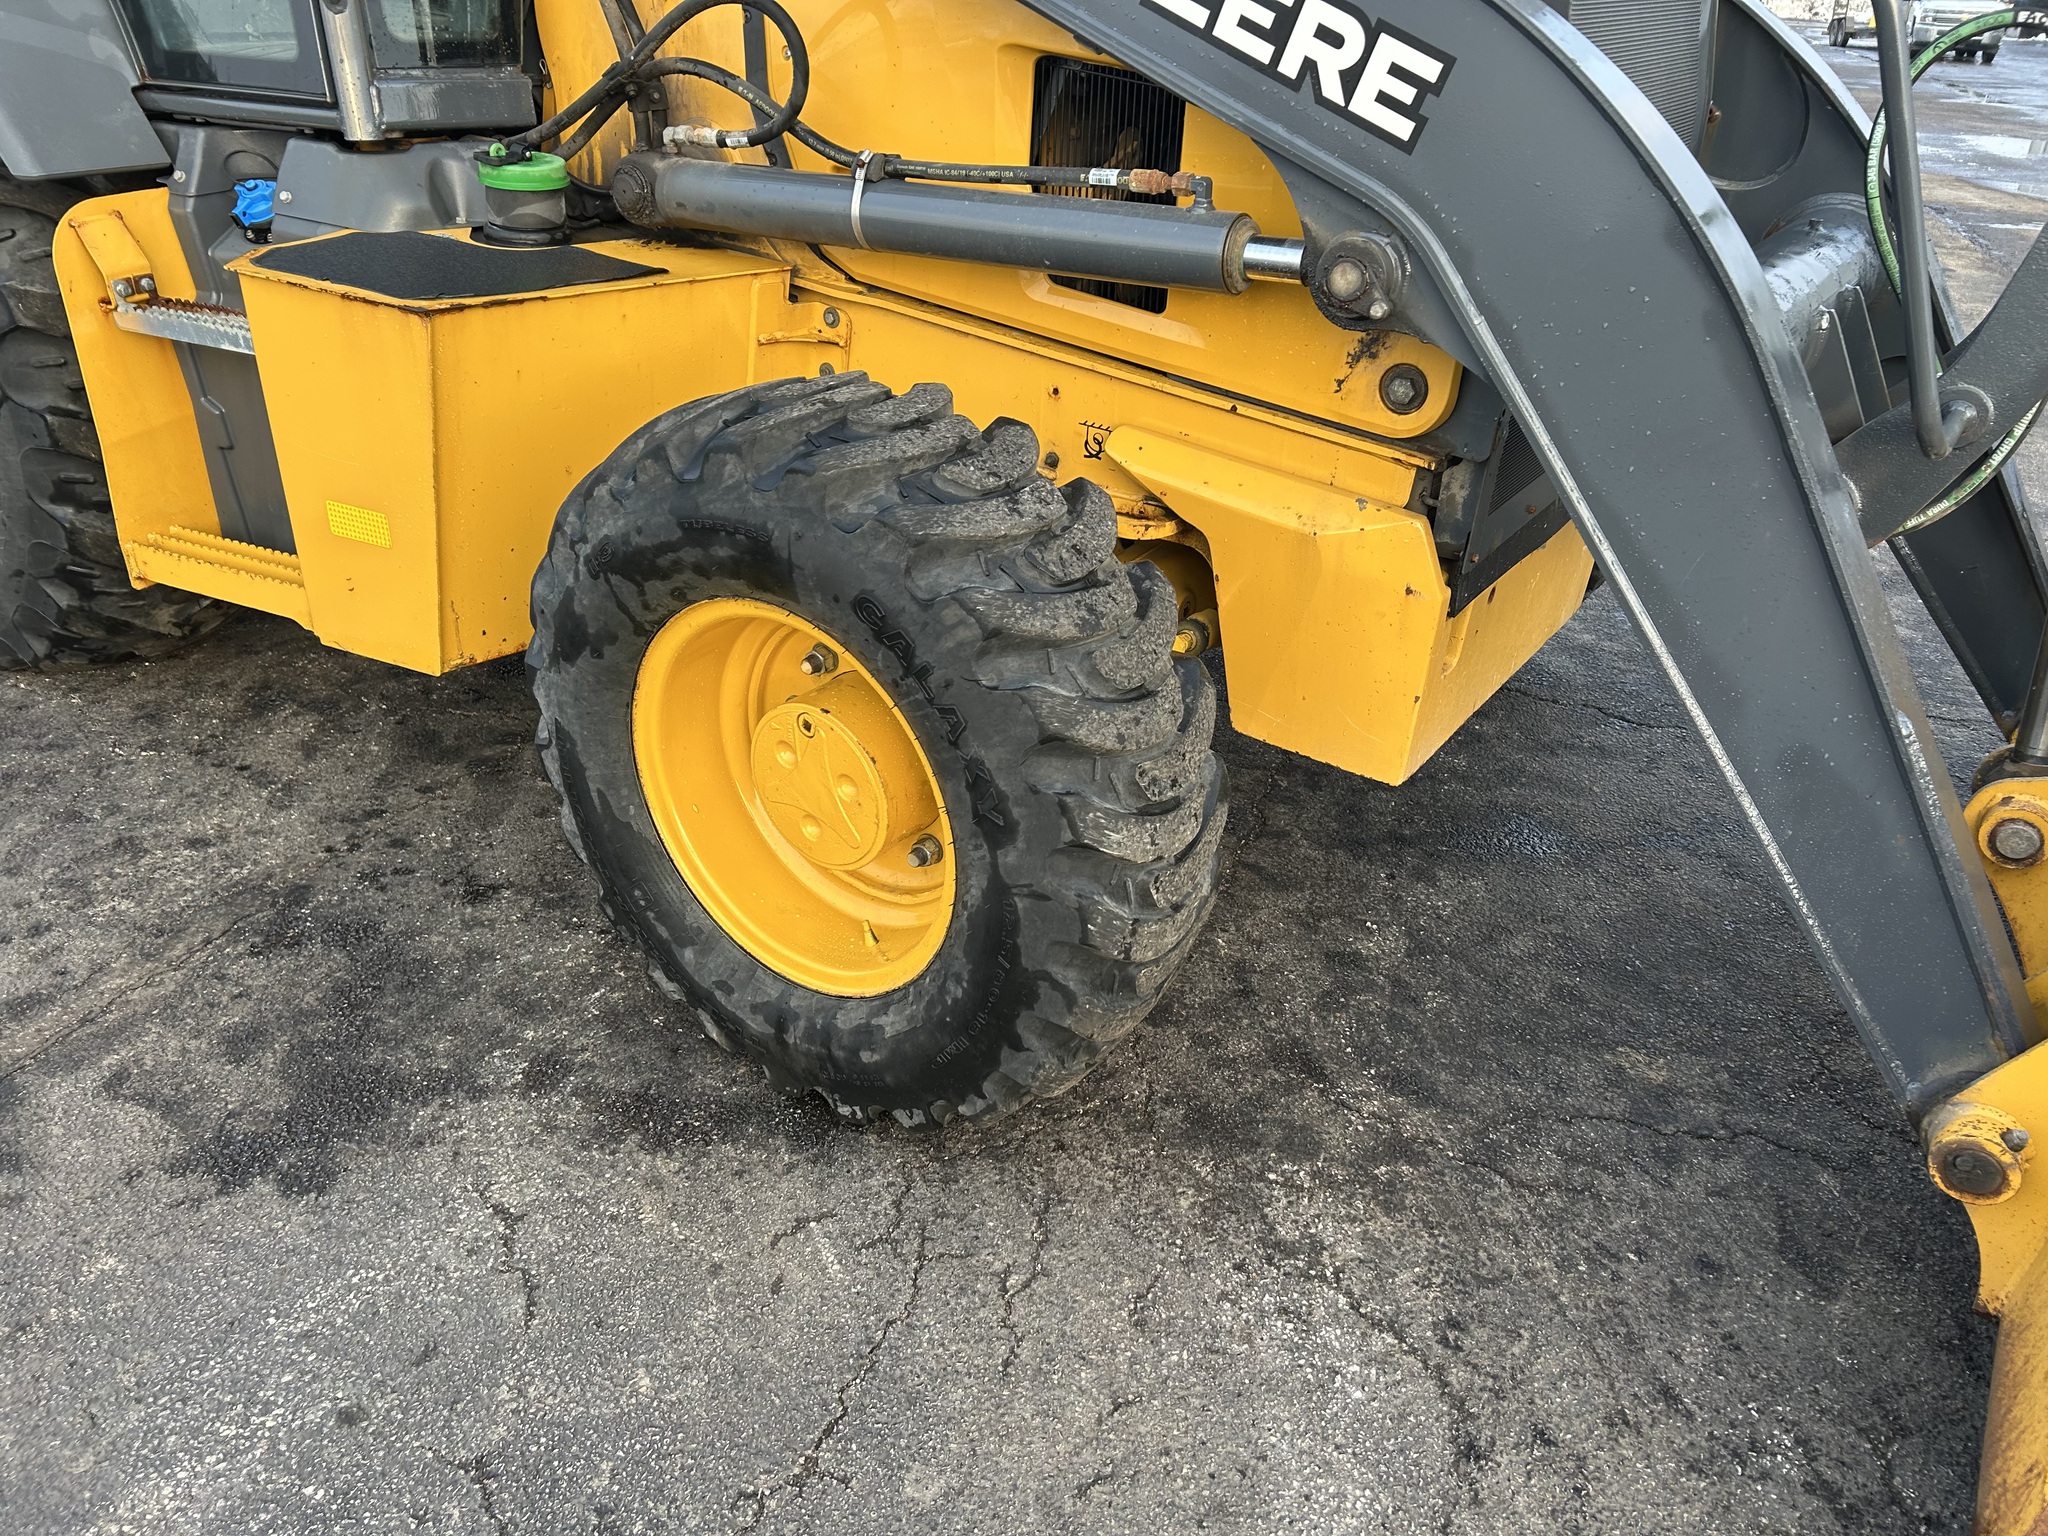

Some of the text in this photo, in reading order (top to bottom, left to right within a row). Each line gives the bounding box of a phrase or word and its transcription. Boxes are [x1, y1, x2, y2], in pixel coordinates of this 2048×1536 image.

[1153, 0, 1444, 142] ERE
[1870, 124, 1885, 146] (5000
[1867, 148, 1880, 166] BAR
[927, 168, 944, 176] MSHA
[1001, 171, 1014, 179] USA
[1867, 168, 1878, 181] 345
[1905, 498, 1949, 528] DURA TUFF
[680, 518, 770, 545] TUBELESS
[851, 594, 1006, 827] GALAXY
